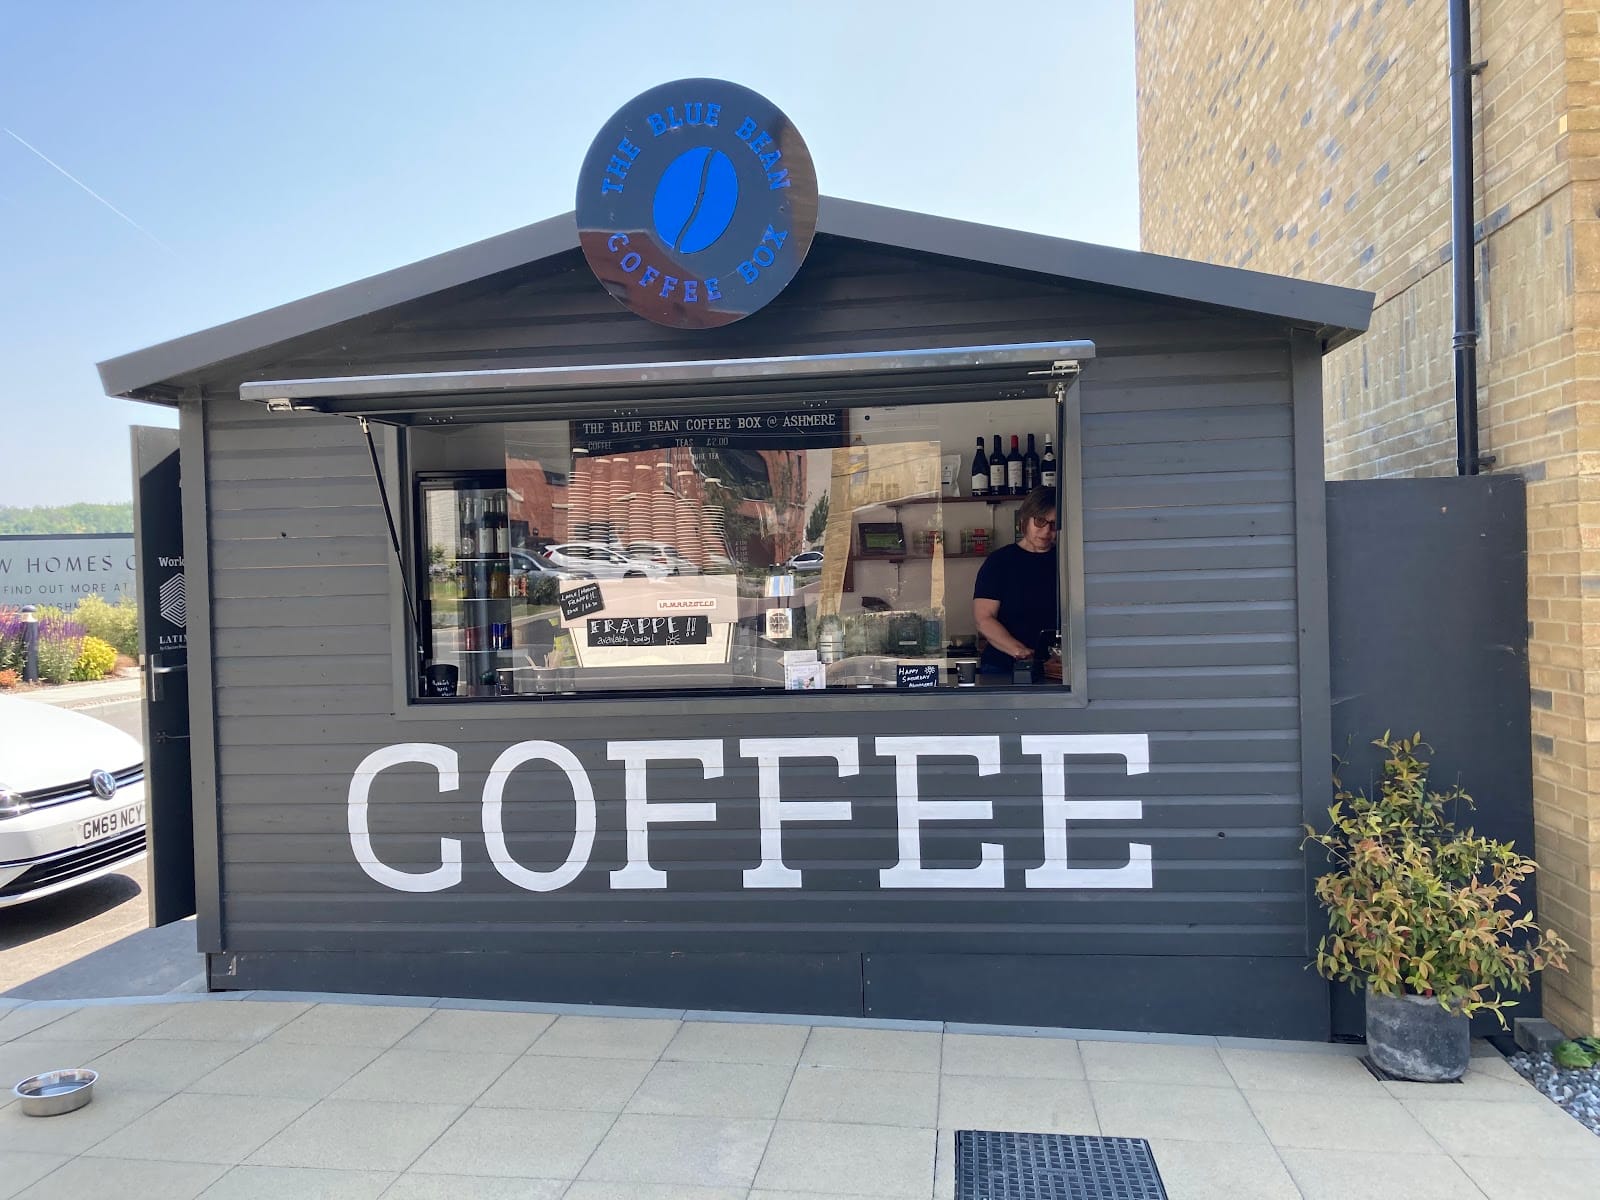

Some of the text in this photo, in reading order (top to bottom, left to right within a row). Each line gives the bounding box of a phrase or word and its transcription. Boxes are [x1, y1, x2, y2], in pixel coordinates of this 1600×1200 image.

[601, 102, 791, 195] THE BLUE BEAN
[607, 224, 788, 303] COFFEE BOX
[583, 414, 835, 434] THE BLUE BEAN COFFEE BOX @ ASHMERE
[675, 438, 694, 448] TEAS
[27, 555, 113, 574] HOMES
[3, 582, 128, 595] FIND OUT MORE AT
[590, 616, 679, 635] FRAPPE
[83, 804, 143, 840] GM69 NCY
[347, 733, 1153, 892] COFFEE
